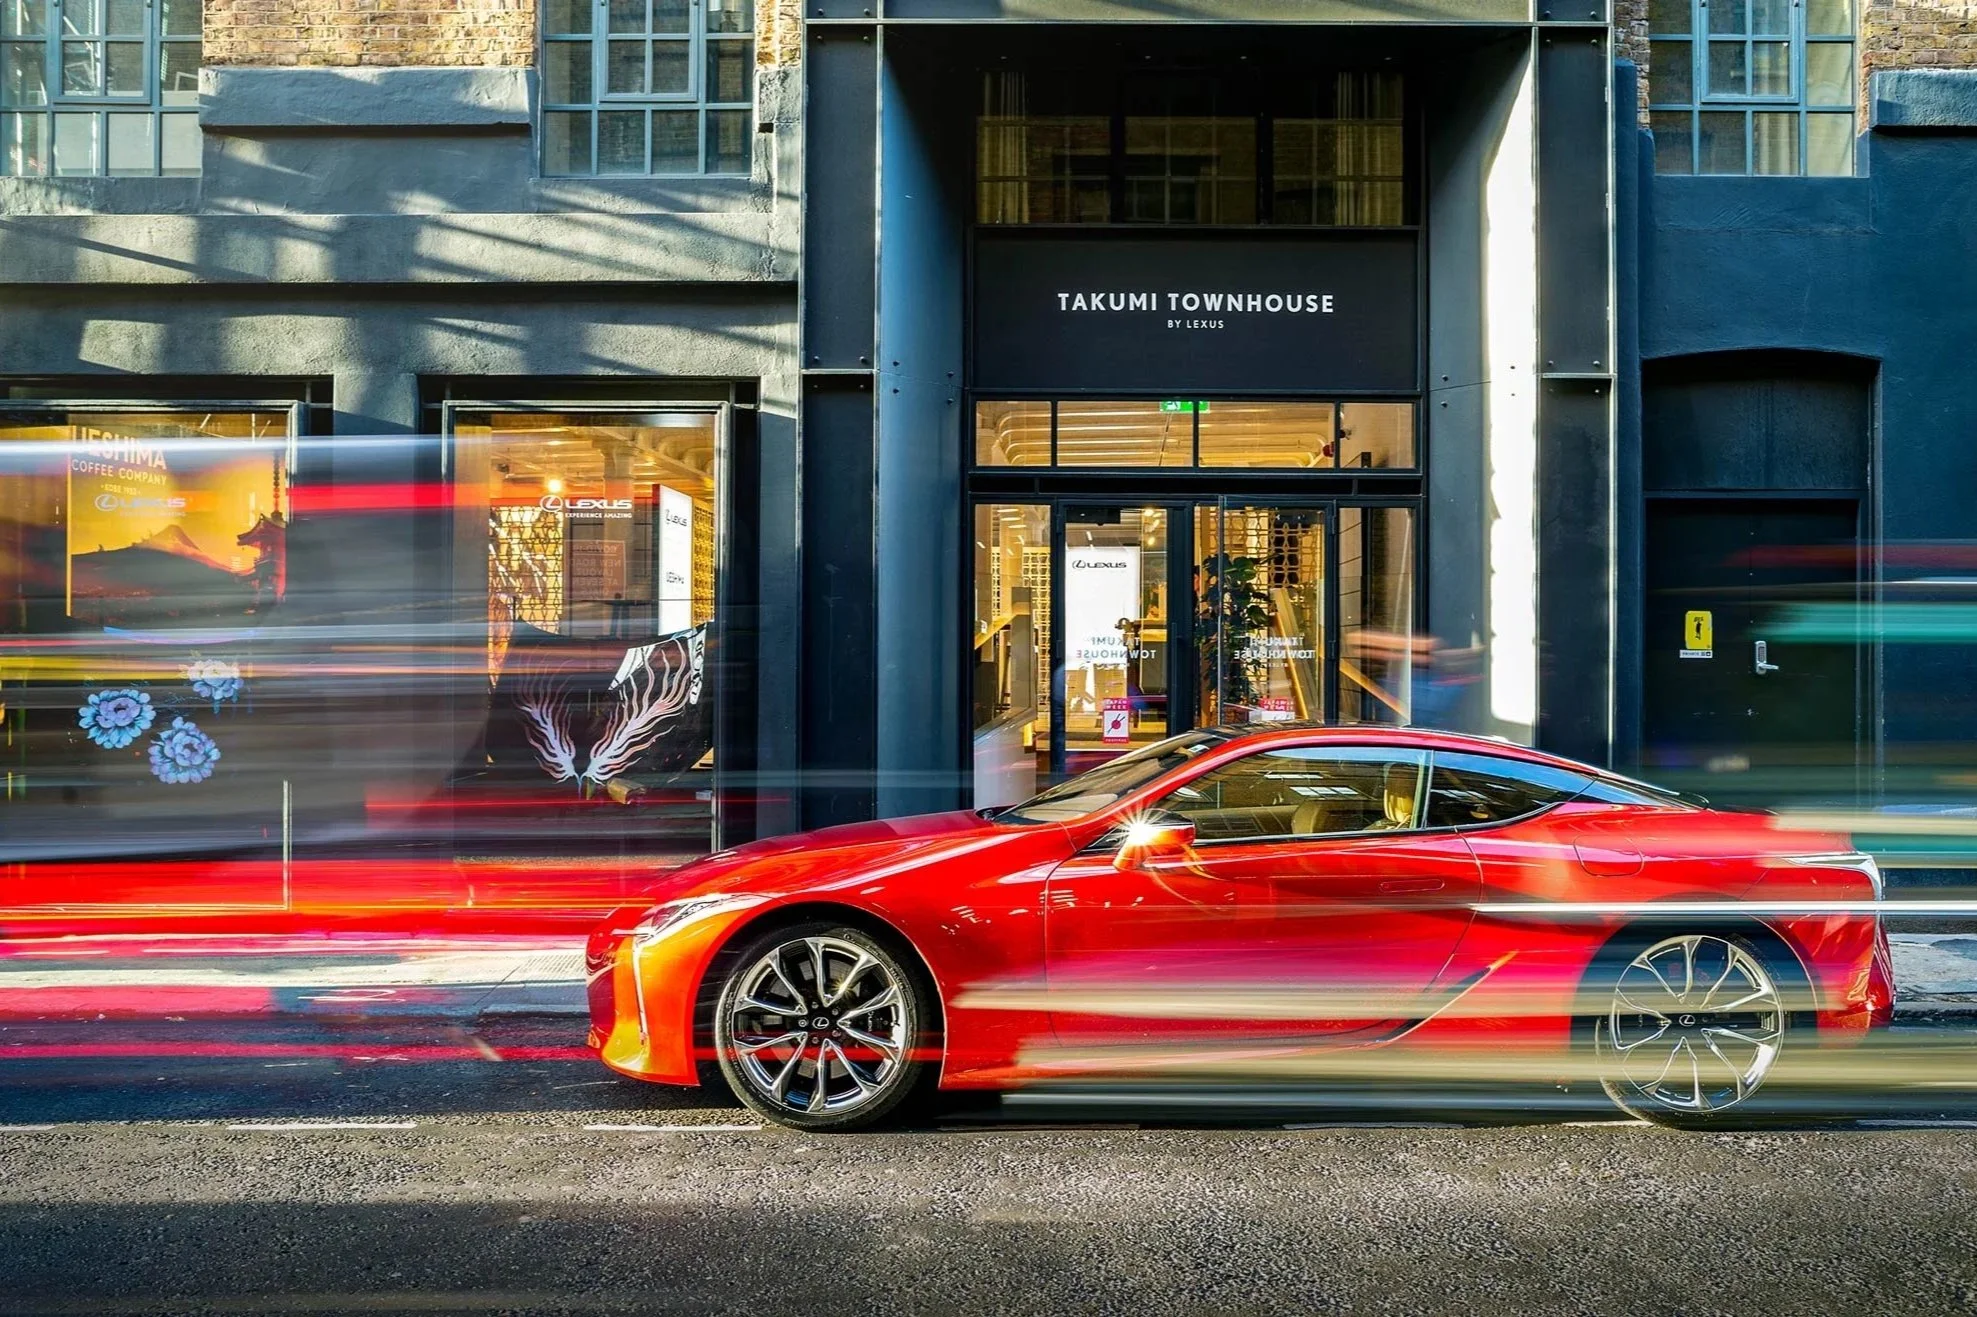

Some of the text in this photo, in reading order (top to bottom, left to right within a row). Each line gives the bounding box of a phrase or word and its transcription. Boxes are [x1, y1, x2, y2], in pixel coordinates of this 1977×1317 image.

[1057, 292, 1334, 314] TAKUMI TOWNHOUSE
[1167, 319, 1225, 330] BY LEXUS
[71, 459, 168, 486] COFFEE COMPANY
[564, 498, 633, 510] LEXUS
